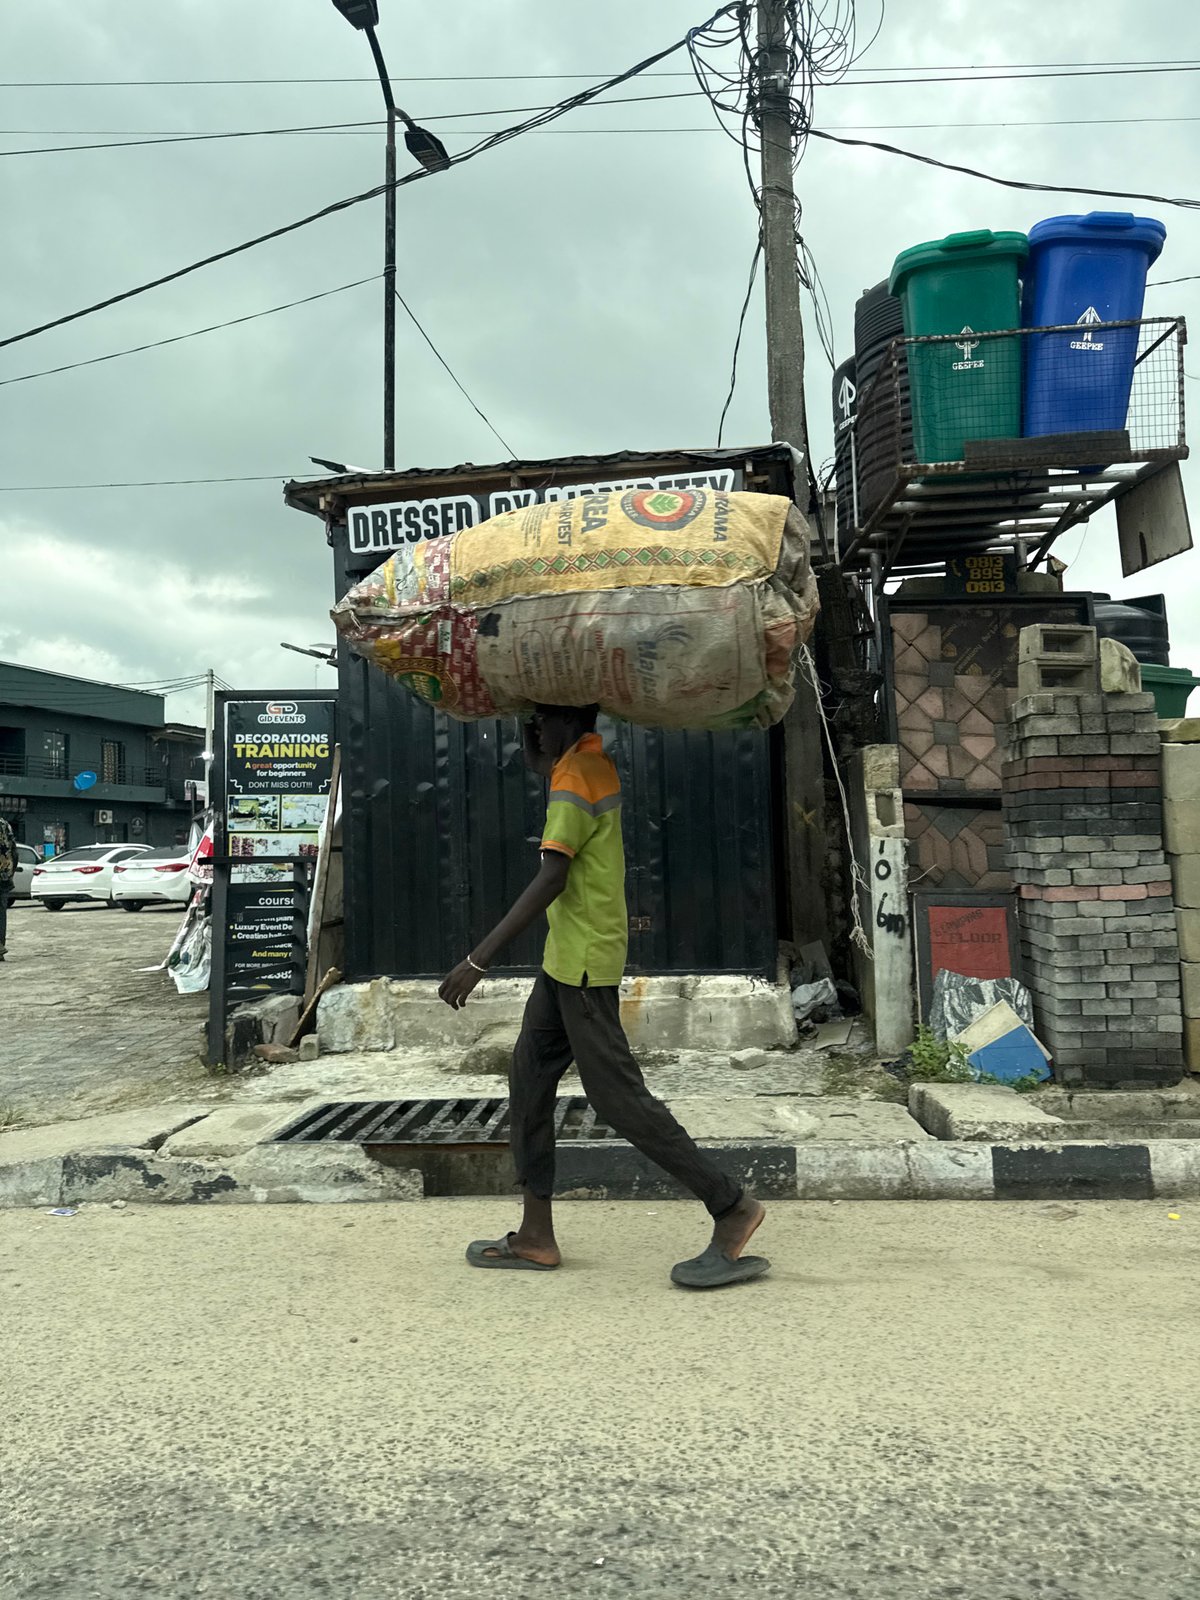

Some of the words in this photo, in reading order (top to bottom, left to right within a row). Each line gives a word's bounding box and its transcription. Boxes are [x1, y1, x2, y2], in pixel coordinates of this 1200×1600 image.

[1070, 341, 1104, 351] GEEPEE
[952, 360, 985, 370] GEEPEE
[352, 501, 473, 549] DRESSED
[966, 556, 1004, 568] 0813
[966, 581, 1006, 593] 0813
[258, 715, 273, 723] GID
[274, 715, 305, 723] EVENTS
[235, 734, 329, 743] DECORATIONS
[233, 744, 329, 758] TRAINING
[273, 762, 317, 770] opportunity
[269, 770, 306, 778] beginners
[951, 933, 1002, 943] FLOOR
